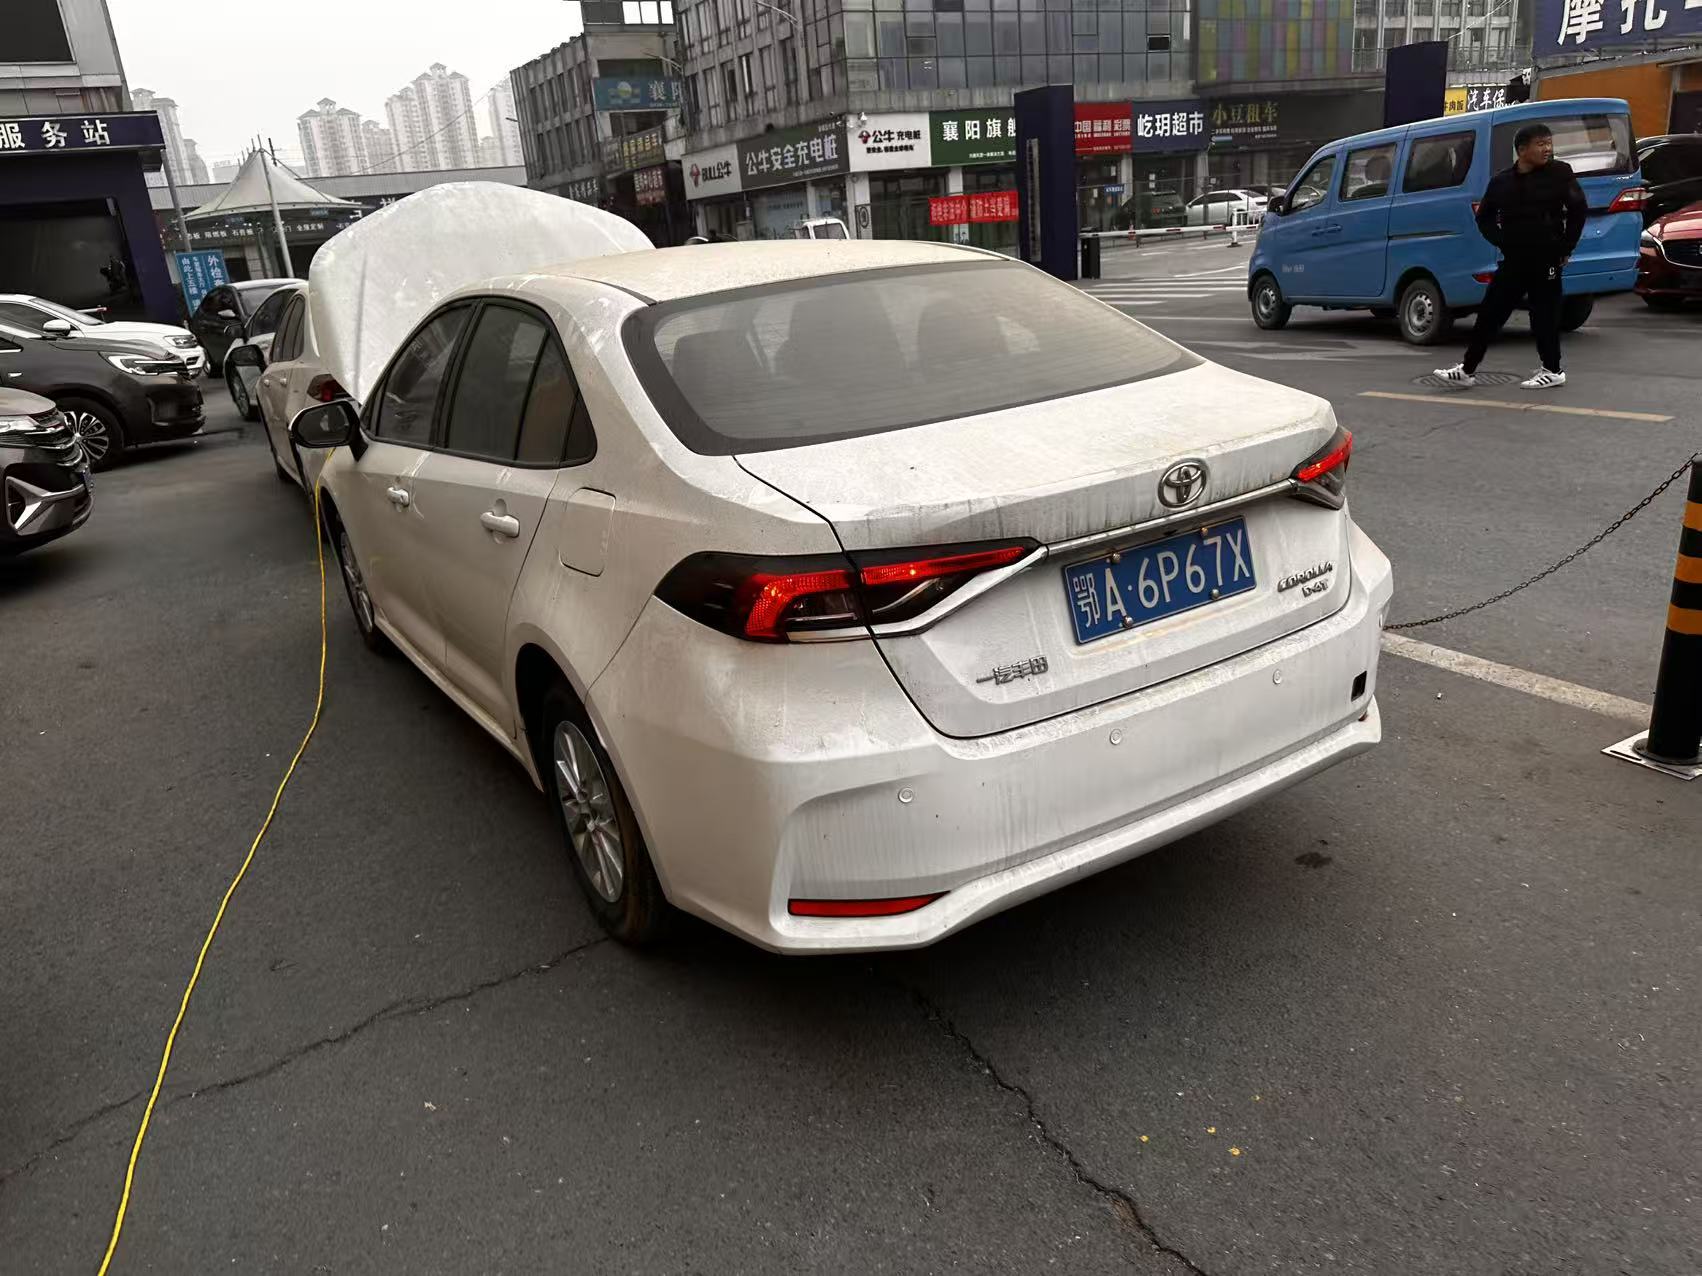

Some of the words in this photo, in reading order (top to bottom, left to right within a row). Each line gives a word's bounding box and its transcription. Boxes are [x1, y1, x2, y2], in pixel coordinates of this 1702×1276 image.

[1137, 111, 1204, 138] 屹玥超市
[1212, 101, 1278, 127] 小豆租车
[0, 119, 110, 149] 服务站
[745, 134, 838, 175] 公牛安全充电桩
[1277, 561, 1333, 593] COROLLA
[976, 655, 1048, 685] 一汽丰田
